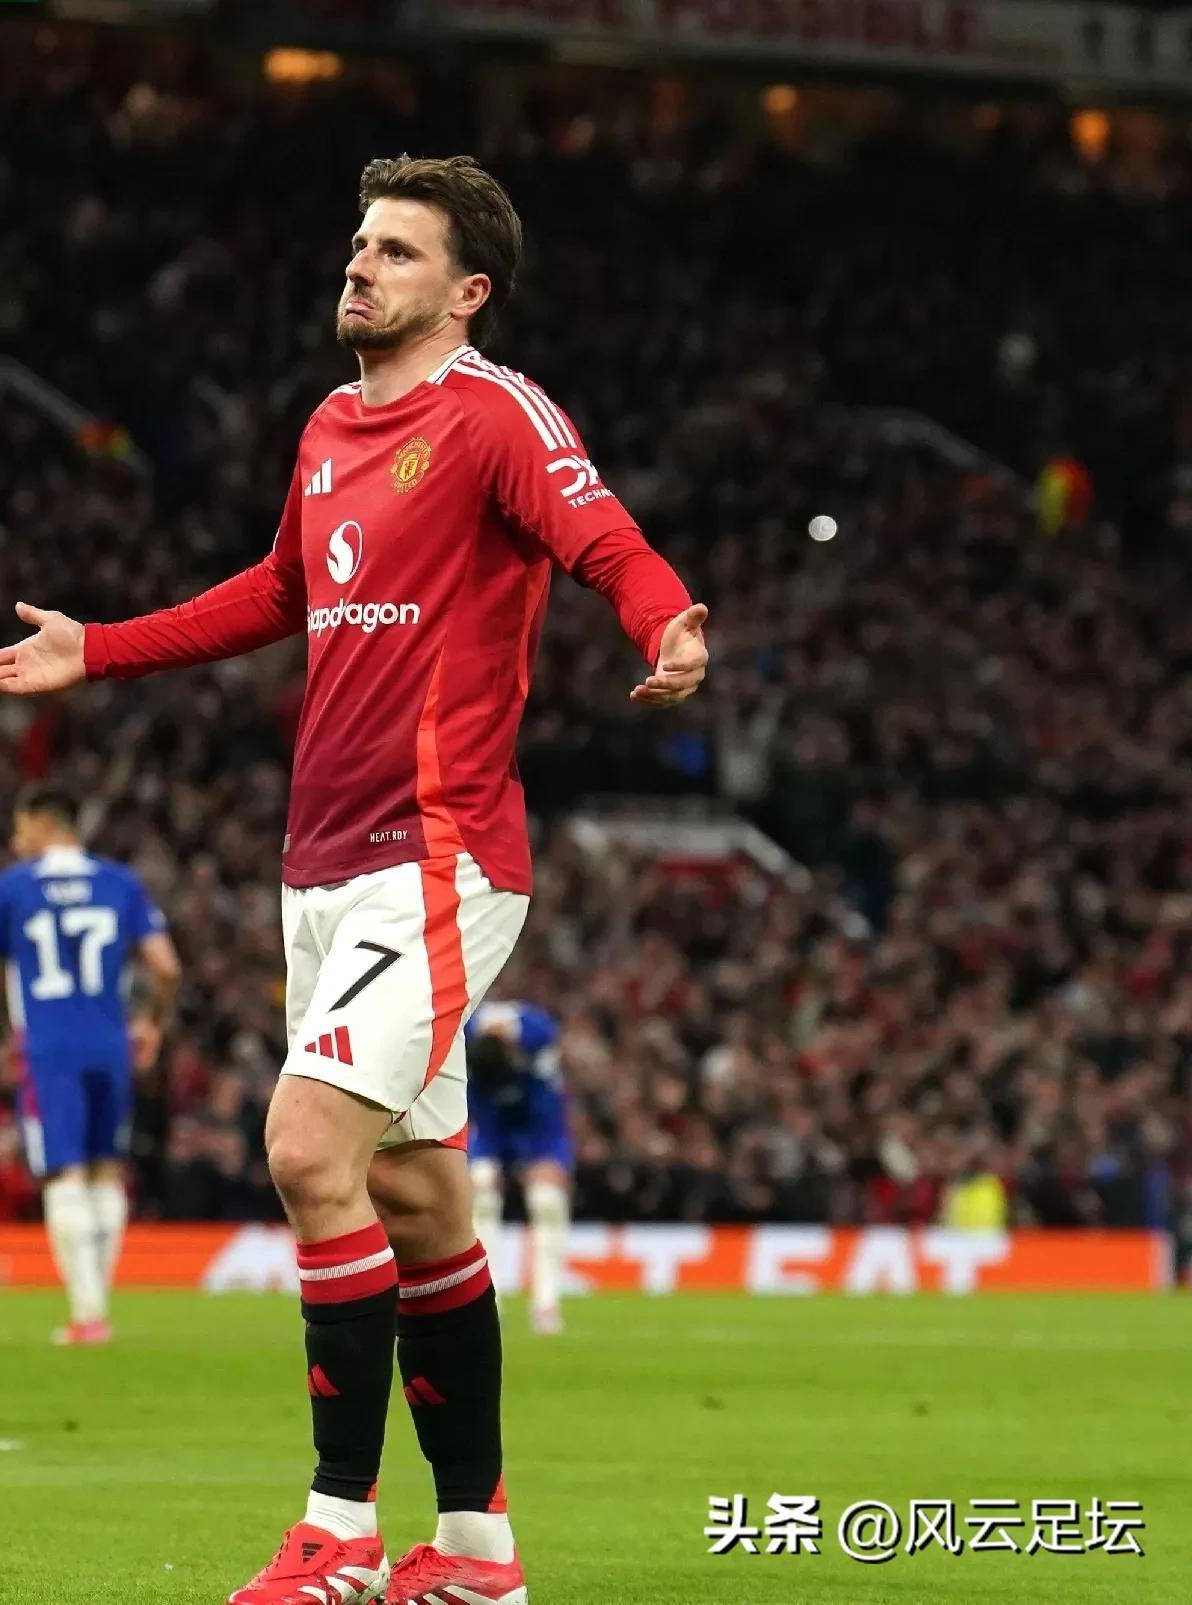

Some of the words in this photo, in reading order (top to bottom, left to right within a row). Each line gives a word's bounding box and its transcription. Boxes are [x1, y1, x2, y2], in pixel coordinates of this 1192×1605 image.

[23, 906, 118, 1000] 17
[326, 939, 404, 1014] 7
[746, 1222, 1011, 1296] EAT
